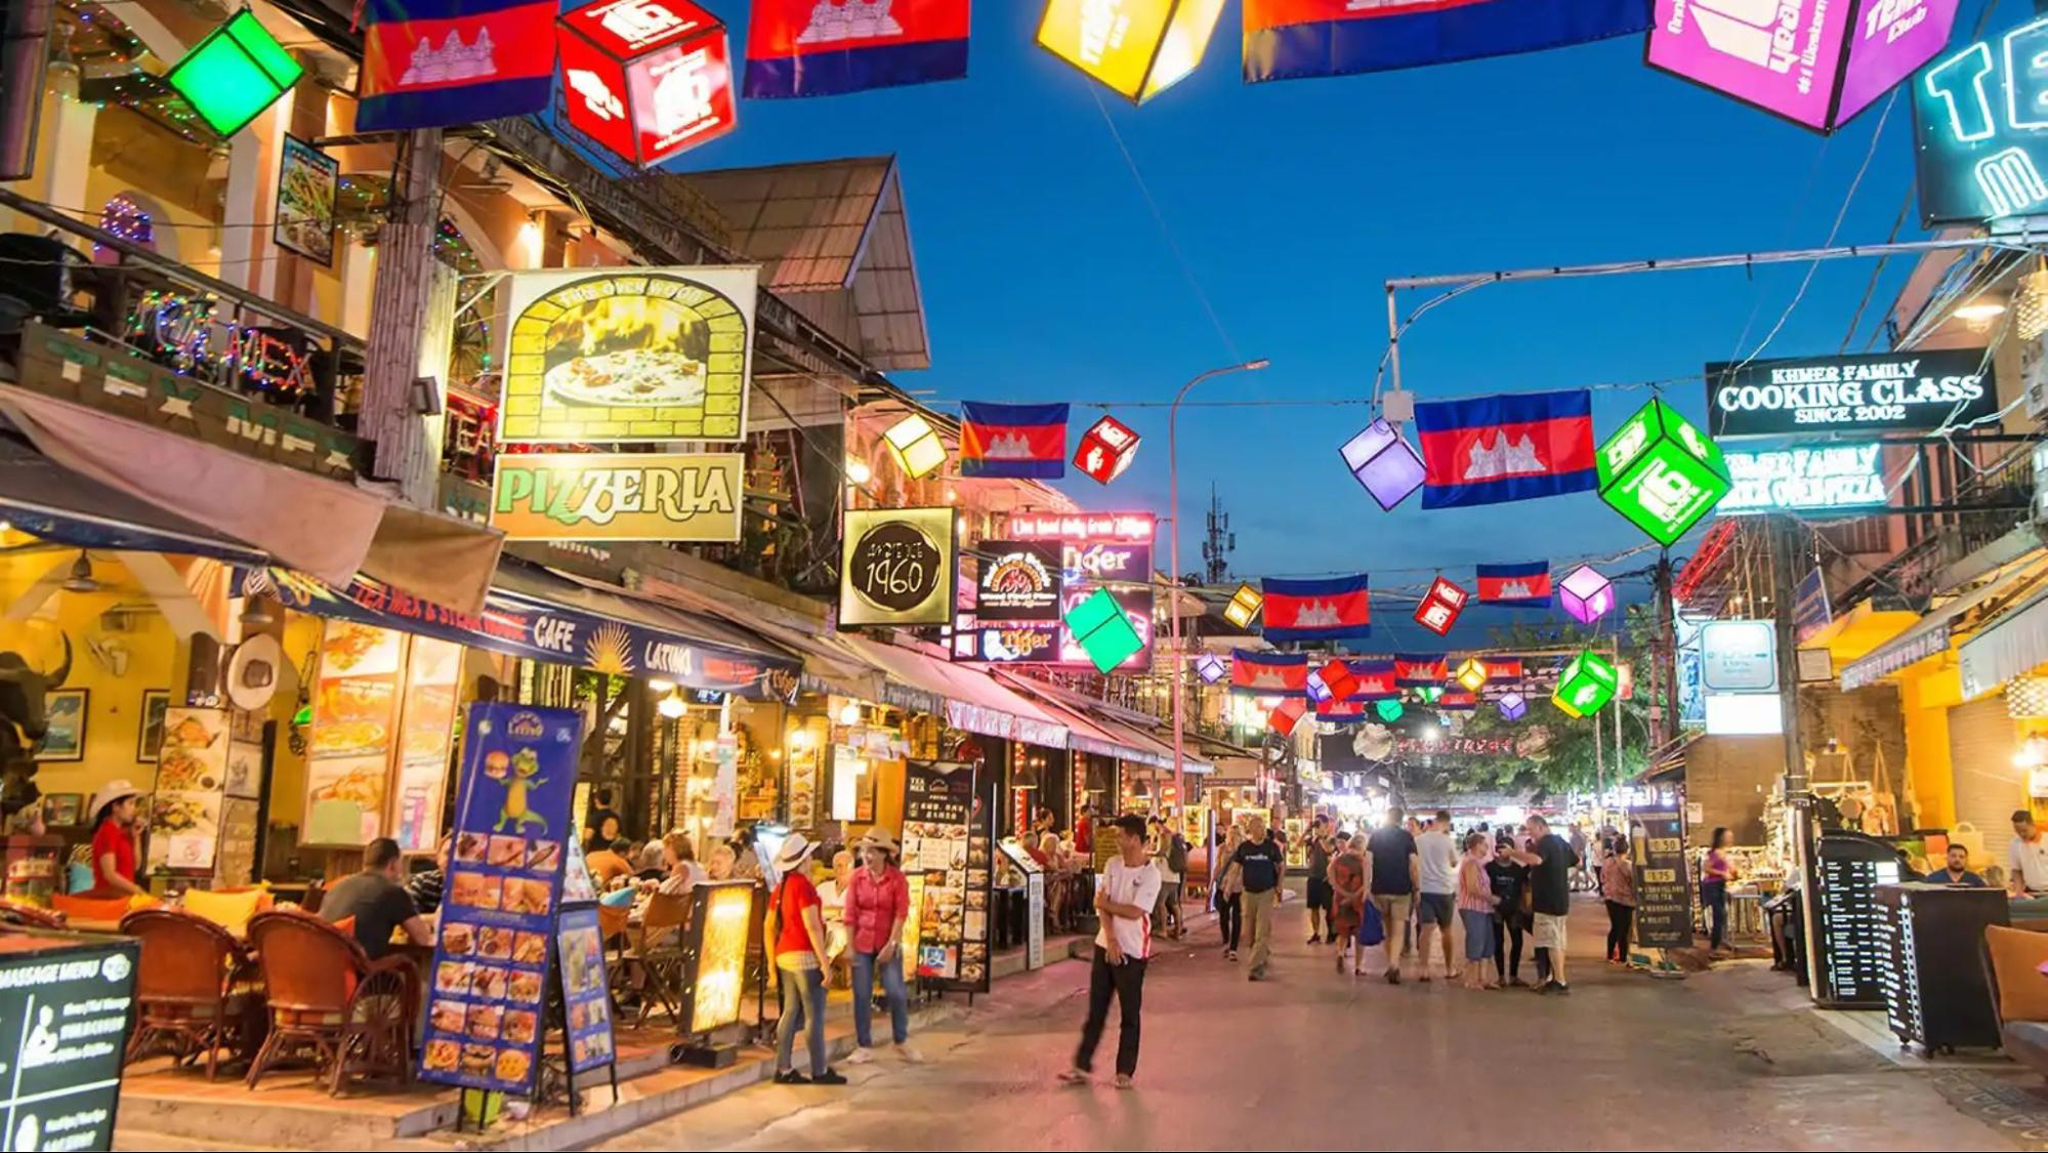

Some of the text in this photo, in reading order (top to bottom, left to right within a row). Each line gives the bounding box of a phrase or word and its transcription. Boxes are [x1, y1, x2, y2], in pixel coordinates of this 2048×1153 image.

[1771, 359, 1920, 385] KHMER FAMILY
[1718, 374, 1984, 411] COOKING CLASS
[1795, 405, 1906, 424] SINCE 2002
[497, 467, 735, 526] PIZZERIA
[866, 558, 924, 595] 1960
[533, 616, 576, 653] CAFE
[644, 641, 691, 675] LATINO
[1000, 629, 1051, 656] Tiger
